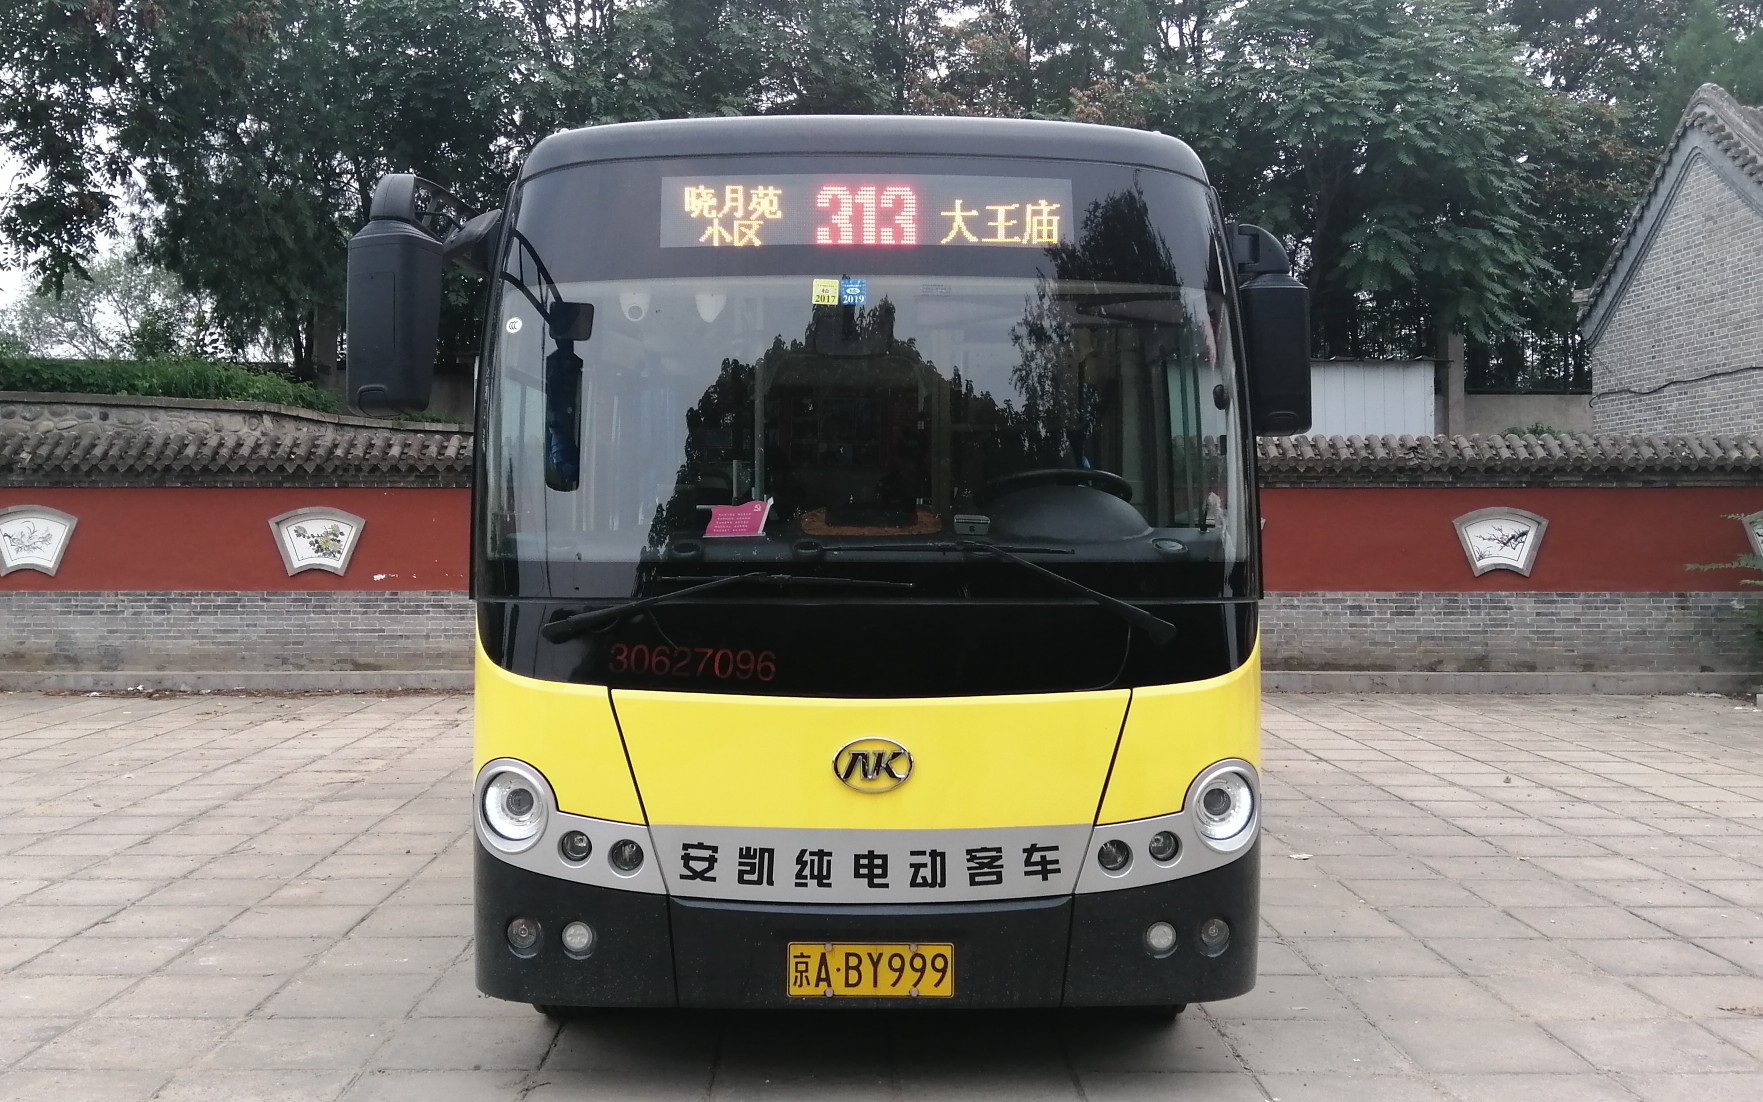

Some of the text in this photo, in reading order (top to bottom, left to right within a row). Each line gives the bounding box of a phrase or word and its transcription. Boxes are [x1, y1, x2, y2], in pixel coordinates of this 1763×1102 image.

[684, 185, 782, 220] 晓月苑
[816, 186, 917, 245] 313
[699, 218, 764, 247] 小区
[940, 199, 1061, 245] 大王庙
[815, 294, 836, 303] 2017
[843, 295, 865, 304] 2019
[609, 643, 776, 681] 30627096
[679, 842, 1062, 889] 安凯纯电动客车
[793, 952, 949, 988] 京A·BY999
